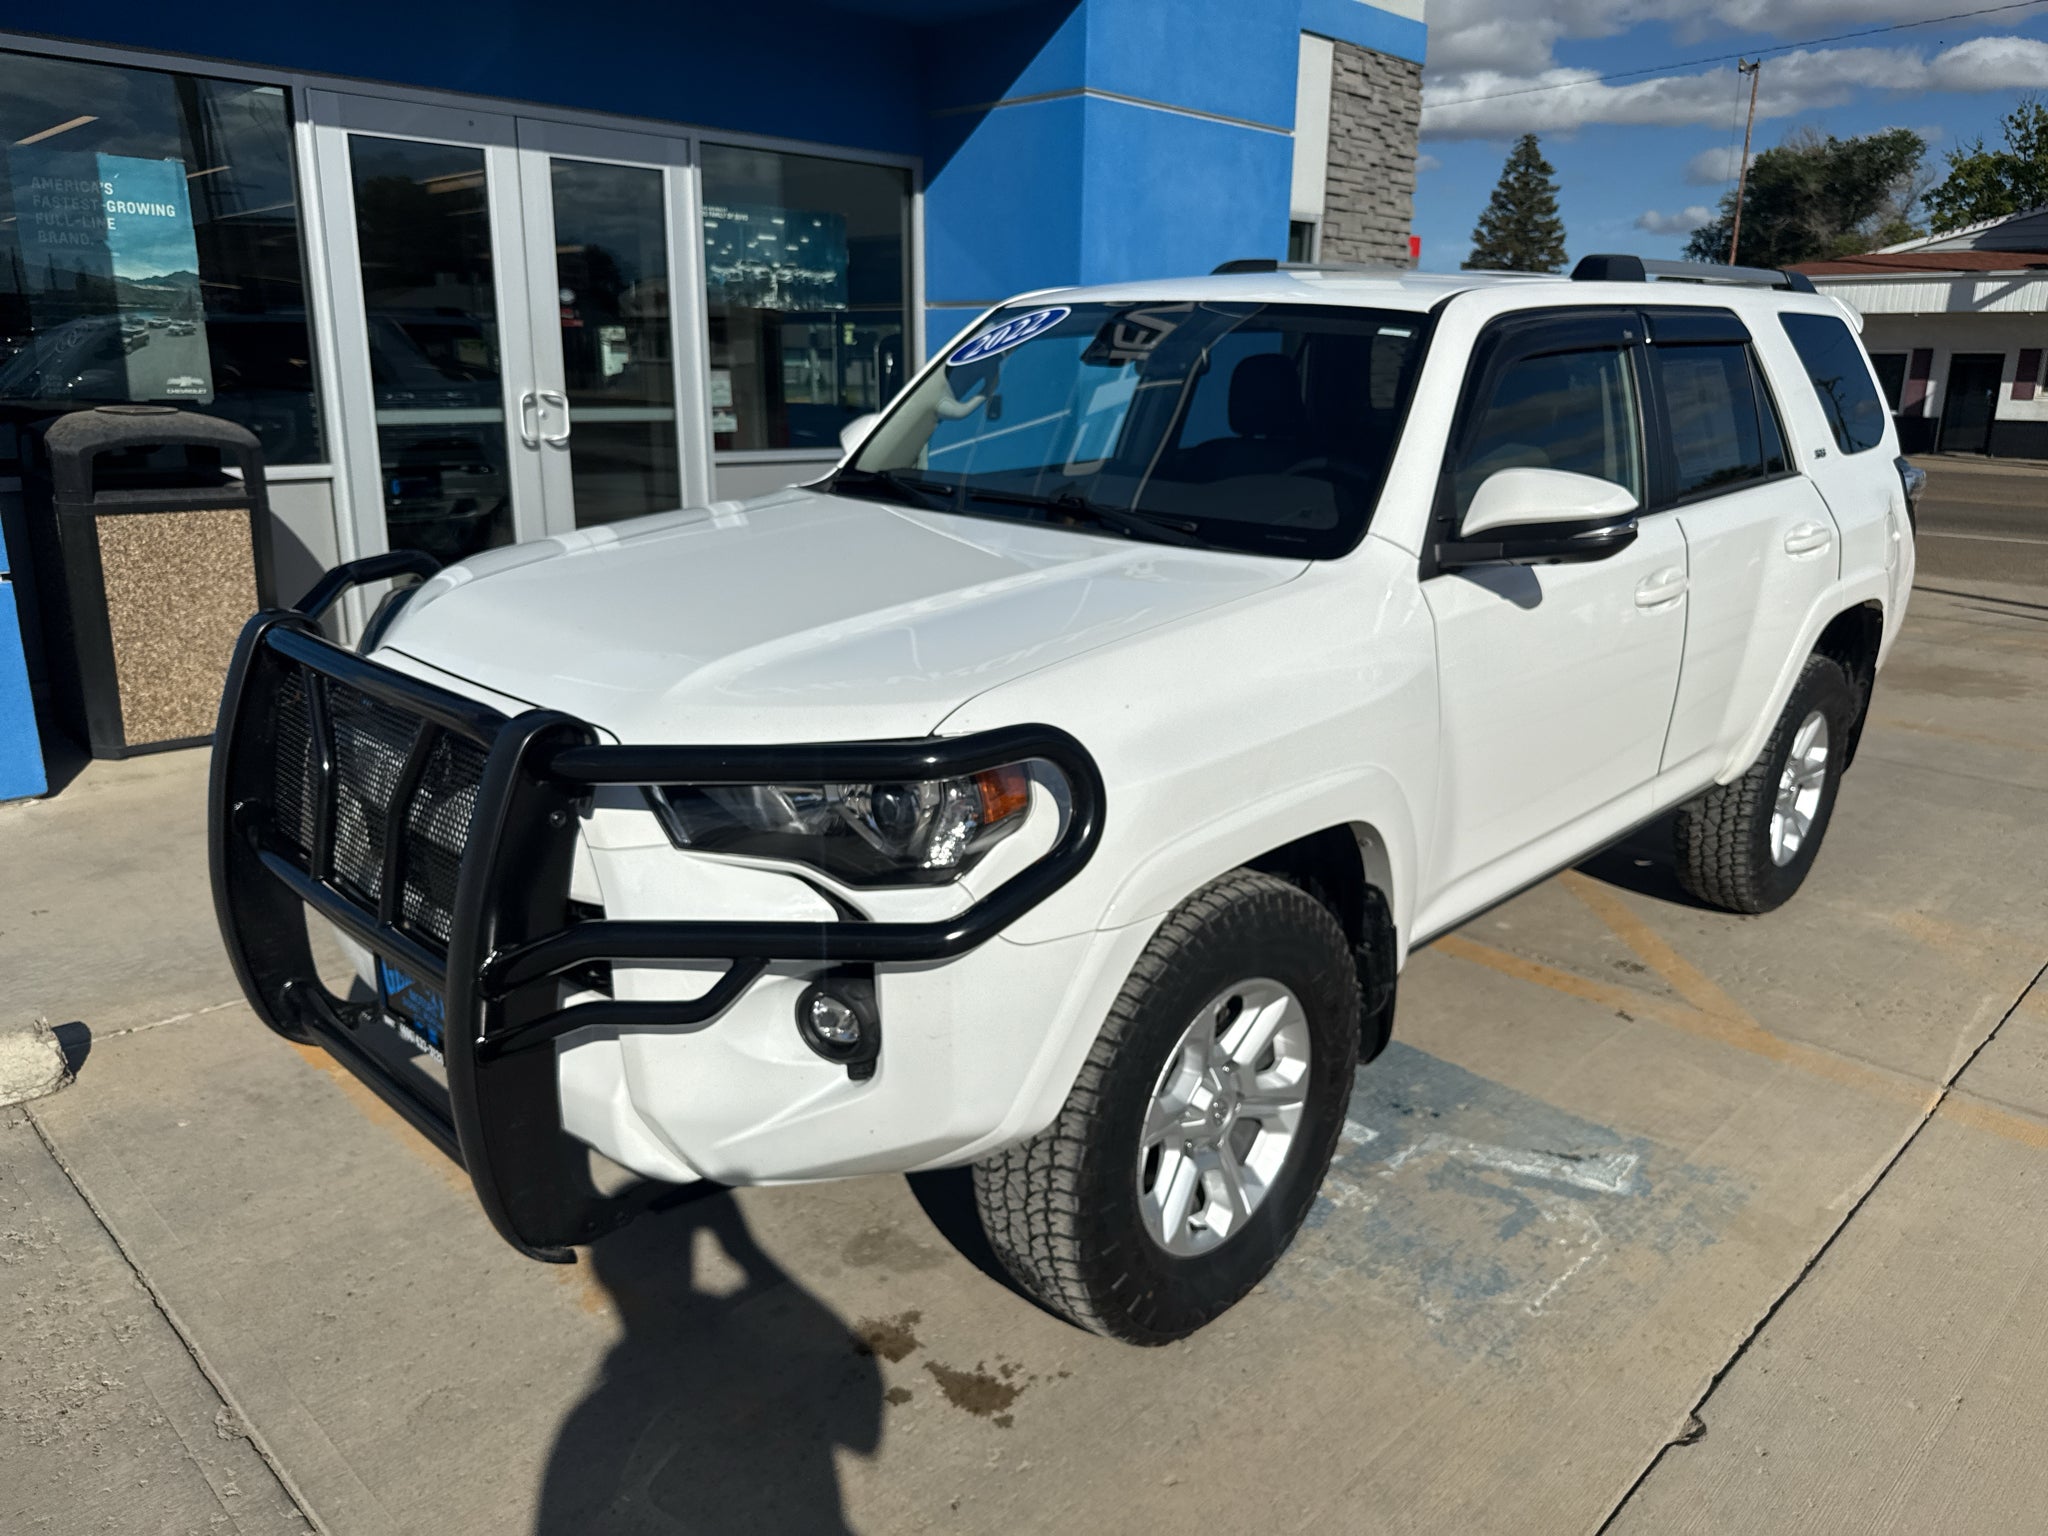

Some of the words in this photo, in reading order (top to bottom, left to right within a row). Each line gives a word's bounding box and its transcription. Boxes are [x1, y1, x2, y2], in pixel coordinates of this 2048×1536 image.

[32, 176, 114, 195] AMERICA'S
[33, 194, 176, 217] FASTEST-GROWING
[35, 211, 116, 230] FULL-LINE
[38, 229, 94, 246] BRAND.
[963, 311, 1051, 360] 2022
